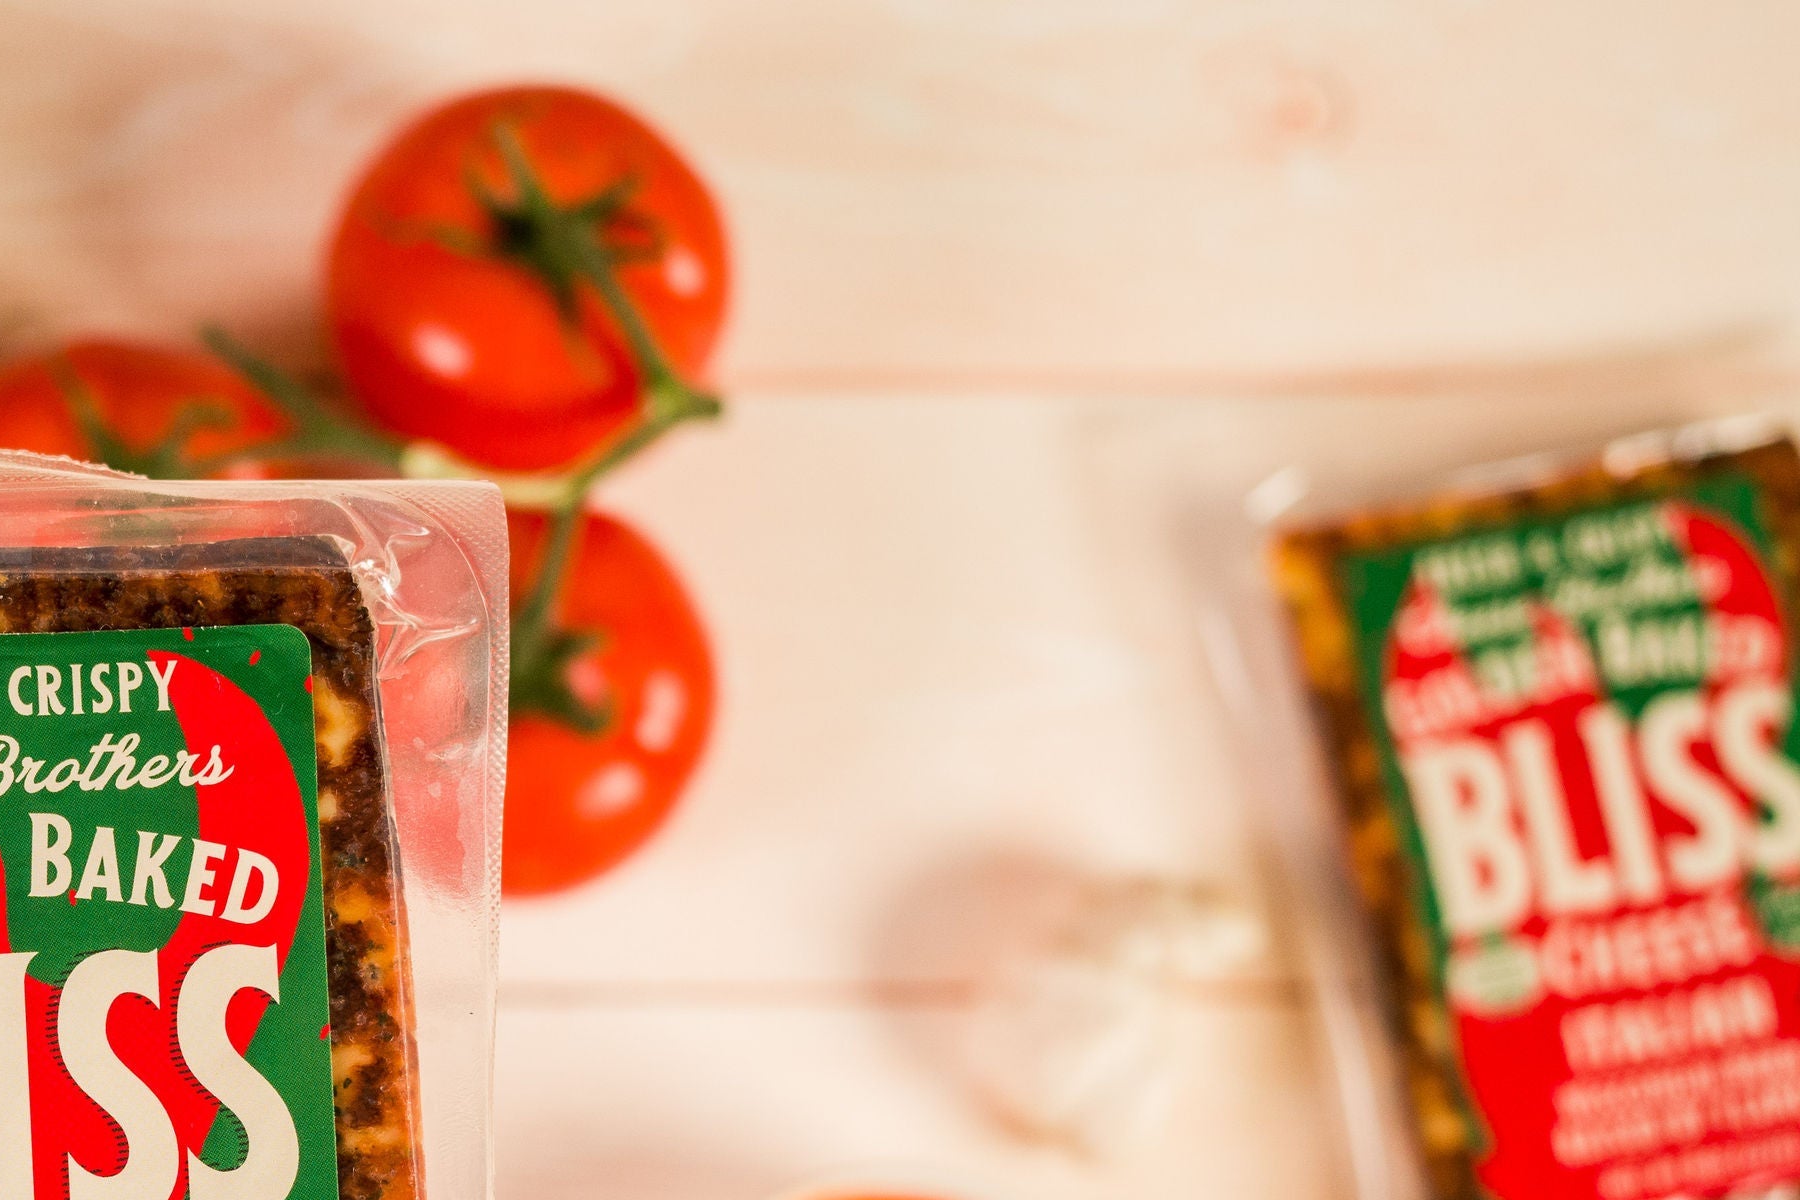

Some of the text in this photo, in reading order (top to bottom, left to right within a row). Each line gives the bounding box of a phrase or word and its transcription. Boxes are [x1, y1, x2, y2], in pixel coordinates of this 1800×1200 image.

[8, 660, 178, 716] CRISPY
[1403, 680, 1800, 938] BLISS
[27, 812, 279, 925] BAKED
